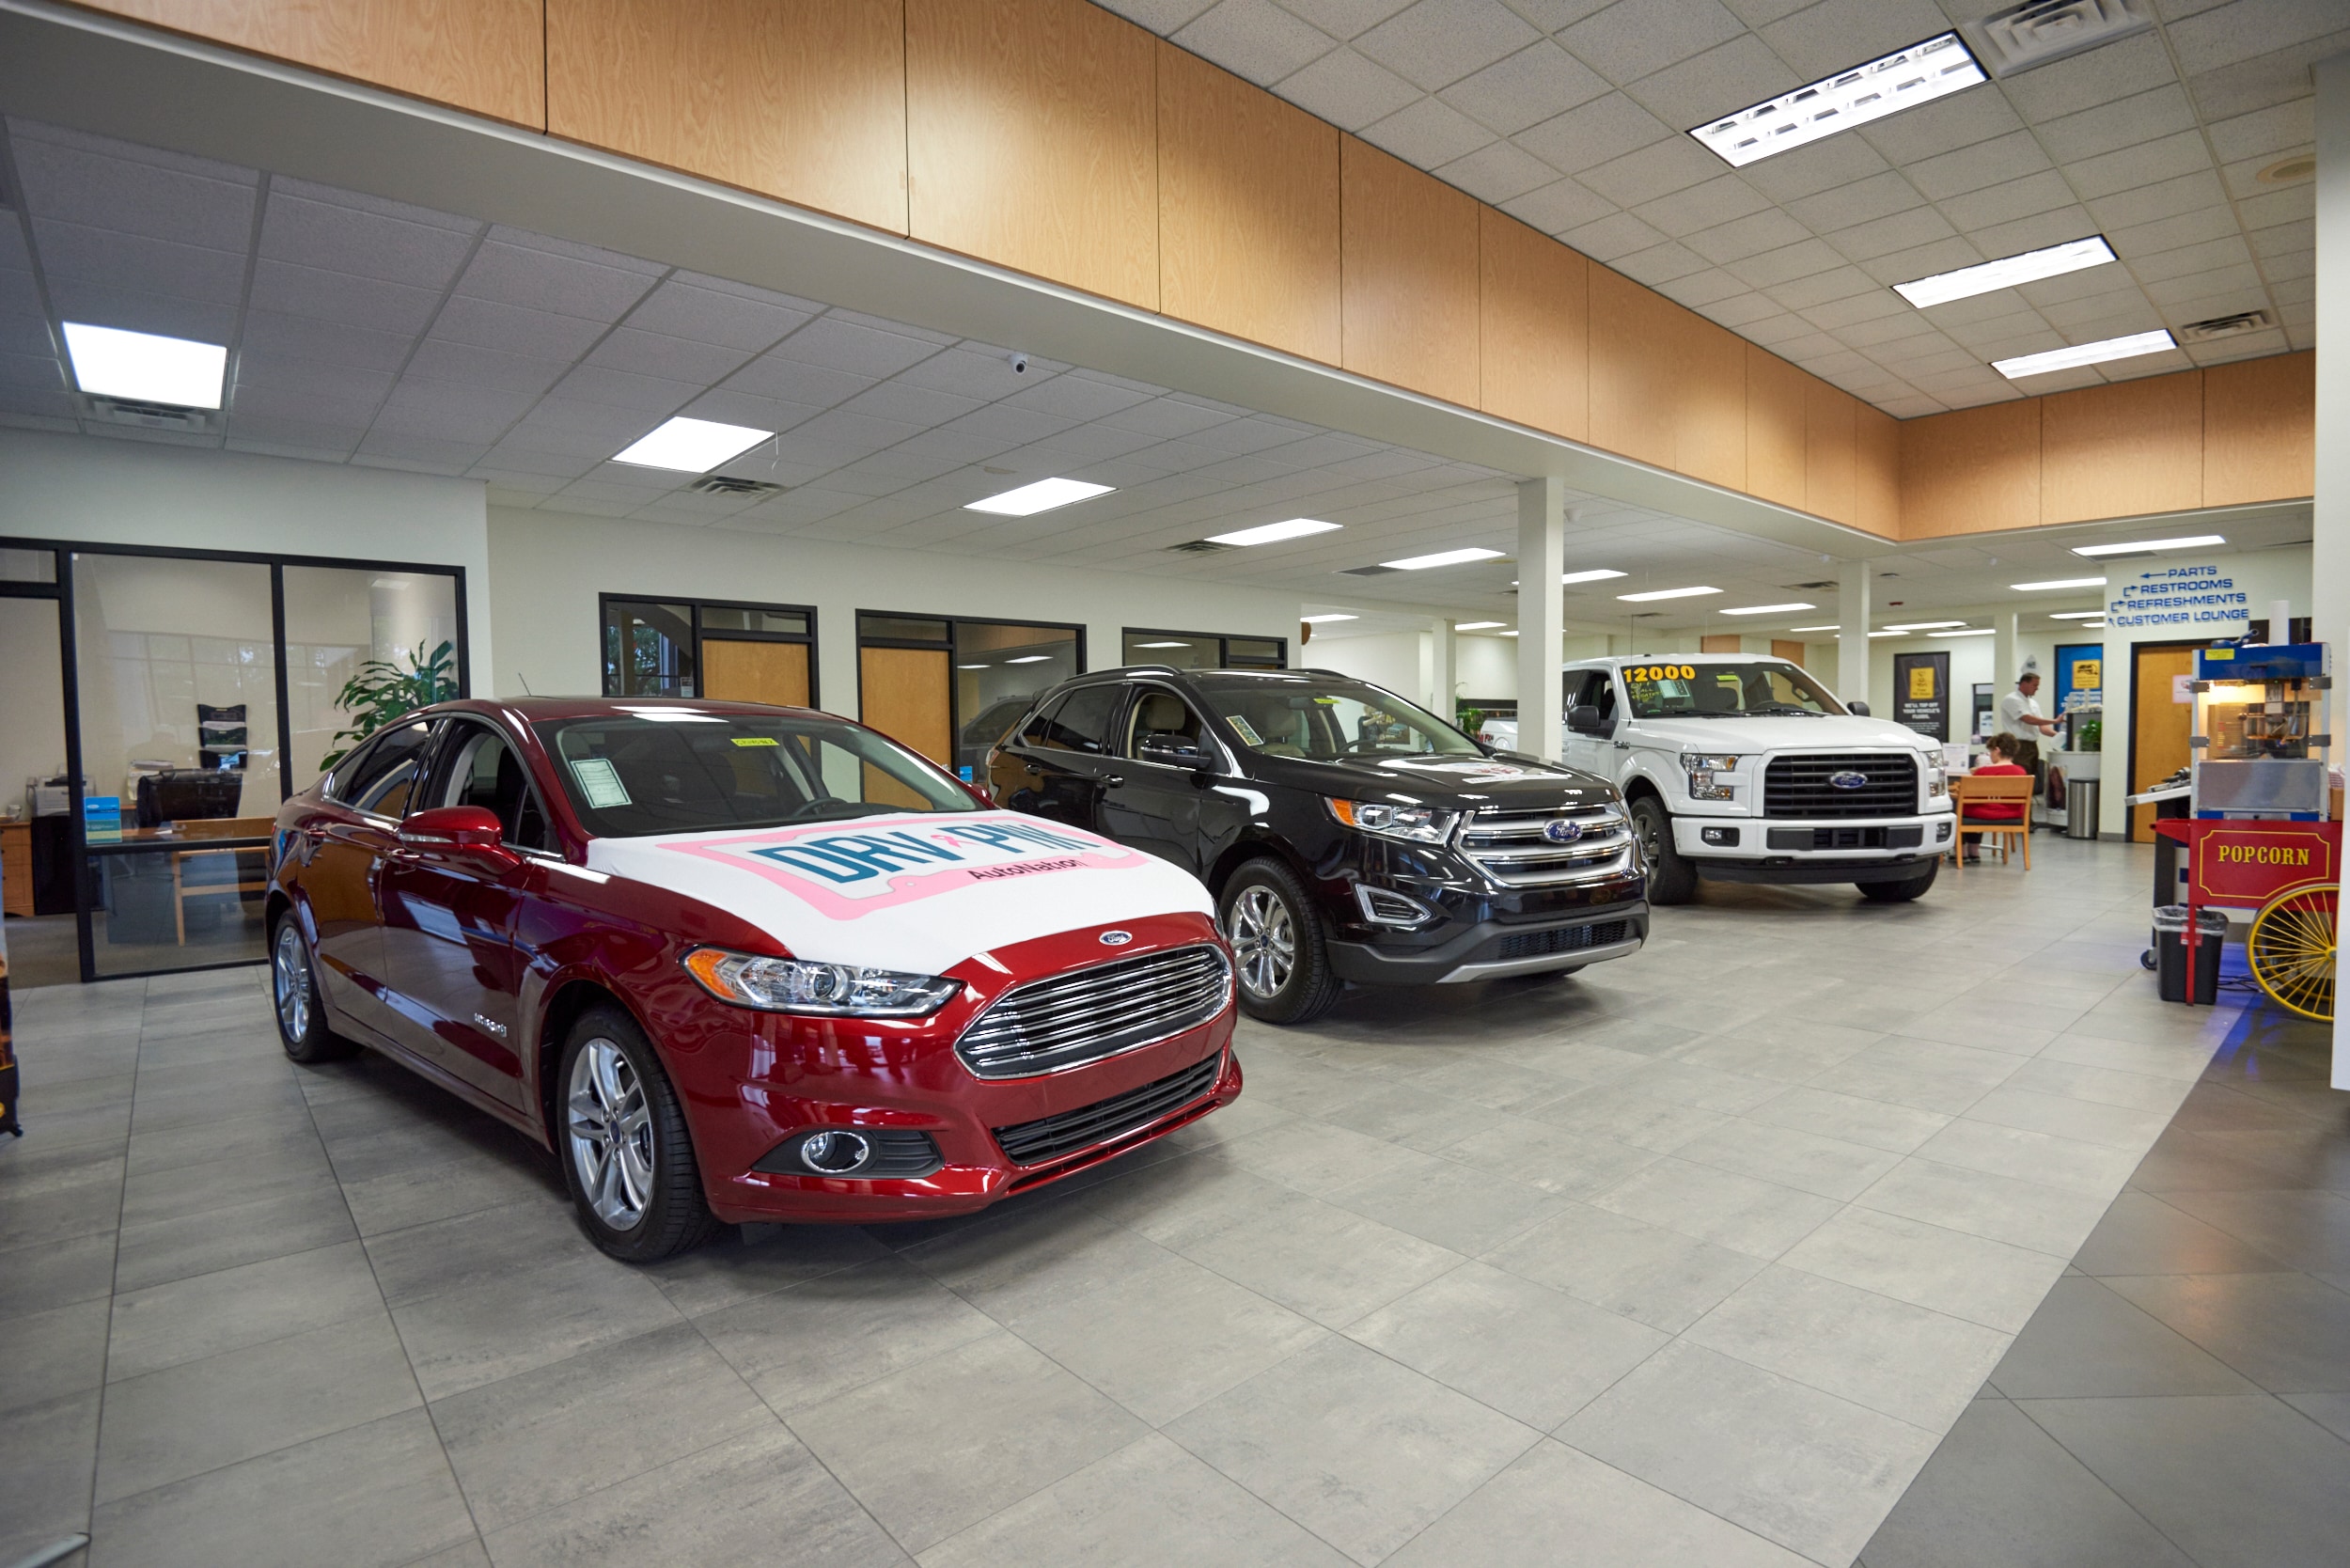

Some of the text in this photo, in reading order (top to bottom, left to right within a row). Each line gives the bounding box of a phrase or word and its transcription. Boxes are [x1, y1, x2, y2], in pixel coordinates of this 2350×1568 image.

[2168, 566, 2217, 578] PARTS
[2140, 578, 2233, 594] RESTROOMS
[2127, 592, 2247, 609] REFRESHMENTS
[2117, 608, 2249, 626] CUSTOMER LOUNGE
[1623, 665, 1696, 683] 12000
[747, 831, 966, 884] DRV
[2218, 844, 2310, 866] POPCORN
[967, 857, 1088, 880] AutoNation
